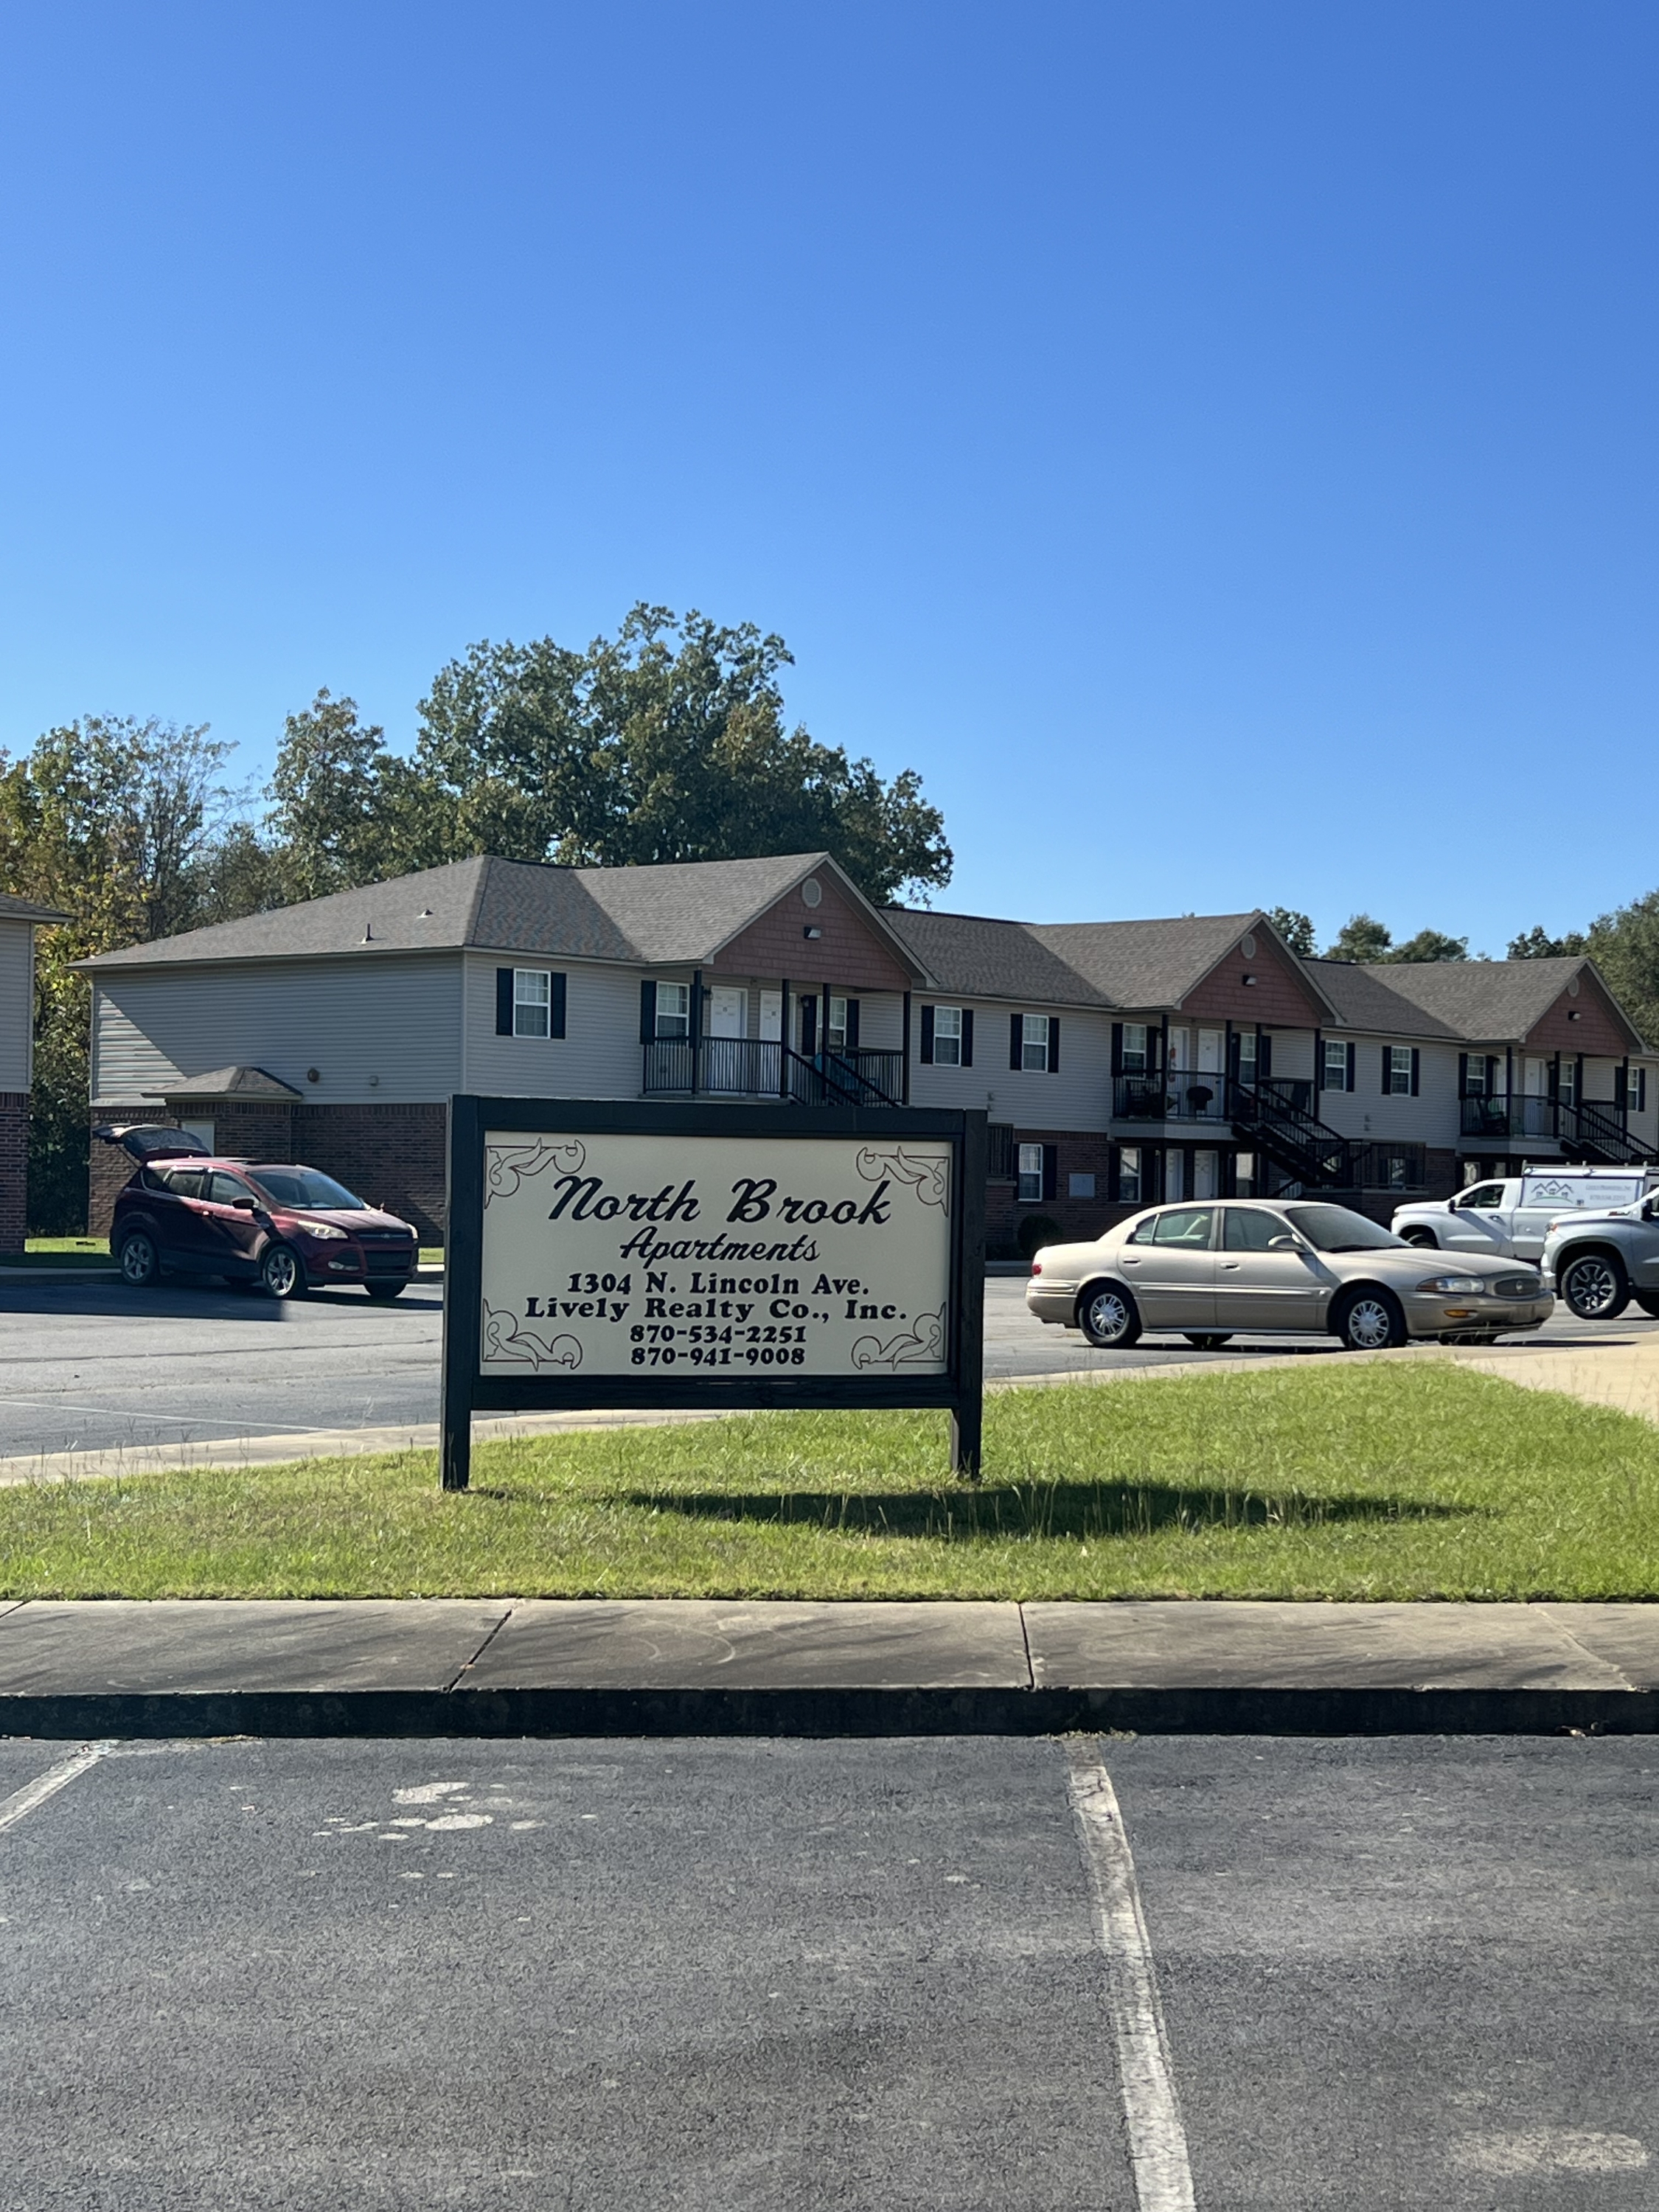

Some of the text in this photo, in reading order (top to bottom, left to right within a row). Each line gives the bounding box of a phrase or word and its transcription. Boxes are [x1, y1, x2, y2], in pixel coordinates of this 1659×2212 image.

[548, 1175, 891, 1225] North Brook
[619, 1225, 821, 1270] Apartments
[567, 1271, 869, 1295] 1304 N. Lincoln Ave.
[524, 1296, 907, 1324] Lively Realty Co., Inc.
[630, 1324, 807, 1345] 870-534-2251
[630, 1346, 806, 1367] 870-941-9008
